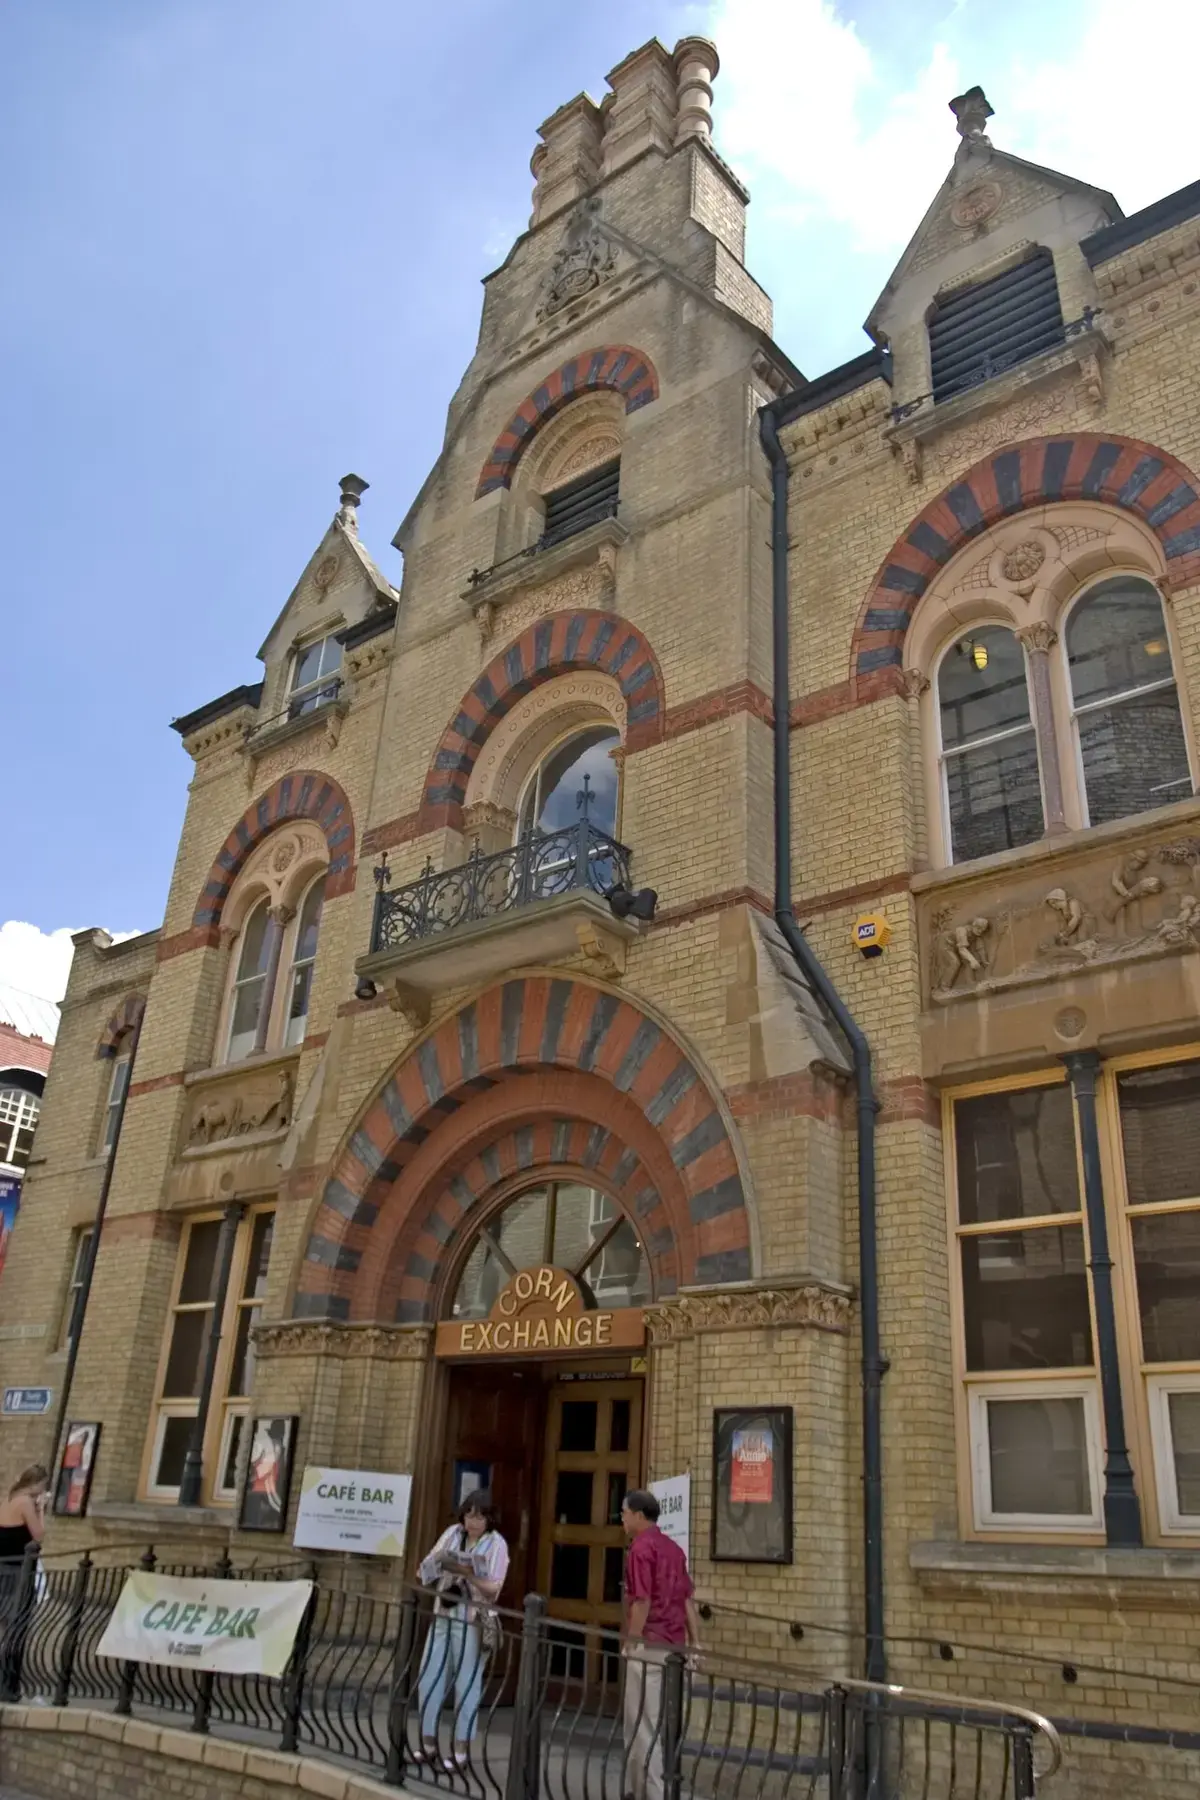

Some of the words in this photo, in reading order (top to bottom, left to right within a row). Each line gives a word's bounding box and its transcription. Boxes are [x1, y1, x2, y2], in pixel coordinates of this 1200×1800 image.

[859, 924, 875, 937] ADT
[499, 1268, 576, 1316] CORN
[460, 1314, 613, 1351] EXCHANGE
[317, 1481, 356, 1501] CAFÉ
[361, 1487, 394, 1504] BAR
[669, 1495, 683, 1514] BAR
[142, 1593, 208, 1635] CAFÉ
[204, 1606, 260, 1639] BAR
